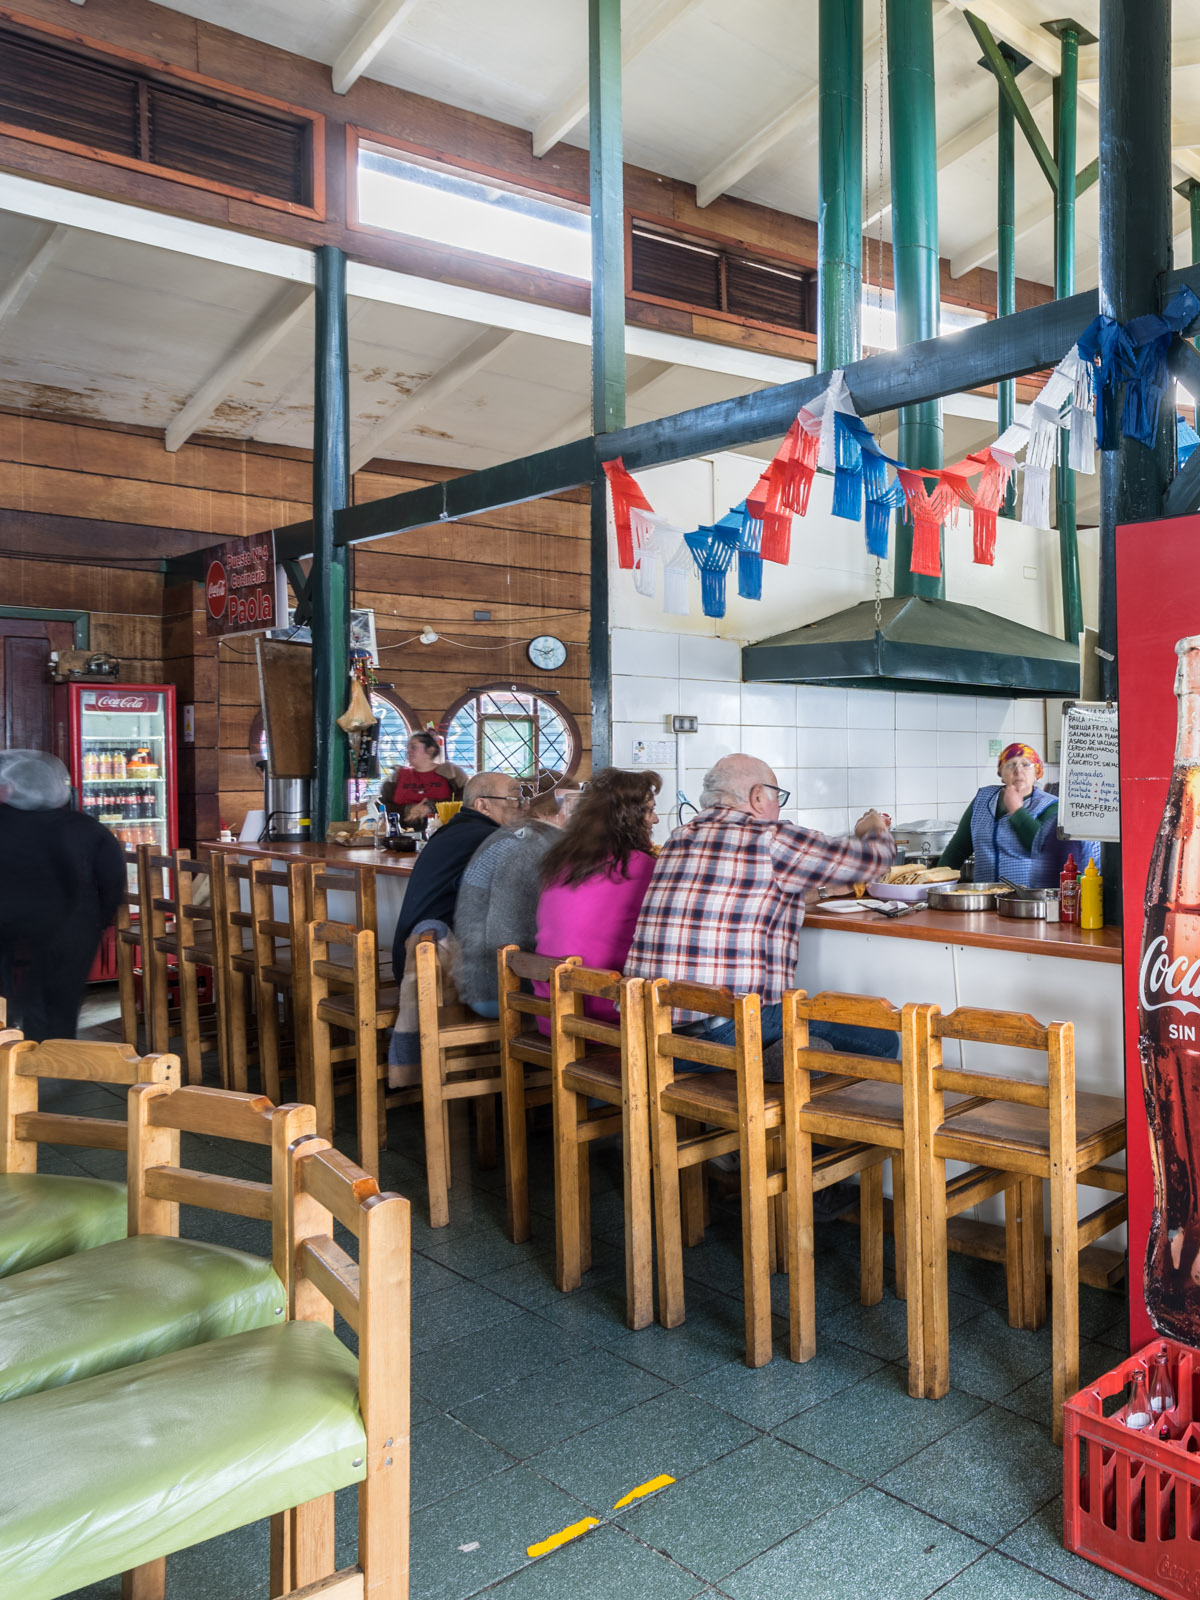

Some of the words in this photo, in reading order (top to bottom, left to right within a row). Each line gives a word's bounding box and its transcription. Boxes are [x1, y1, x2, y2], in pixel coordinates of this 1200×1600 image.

[227, 551, 251, 570] Puesto
[228, 588, 272, 626] Paola
[98, 696, 145, 708] Coca-Cola
[1067, 751, 1099, 760] CURANTO
[1071, 810, 1105, 819] EFECTIVO
[1169, 1024, 1195, 1042] SIN
